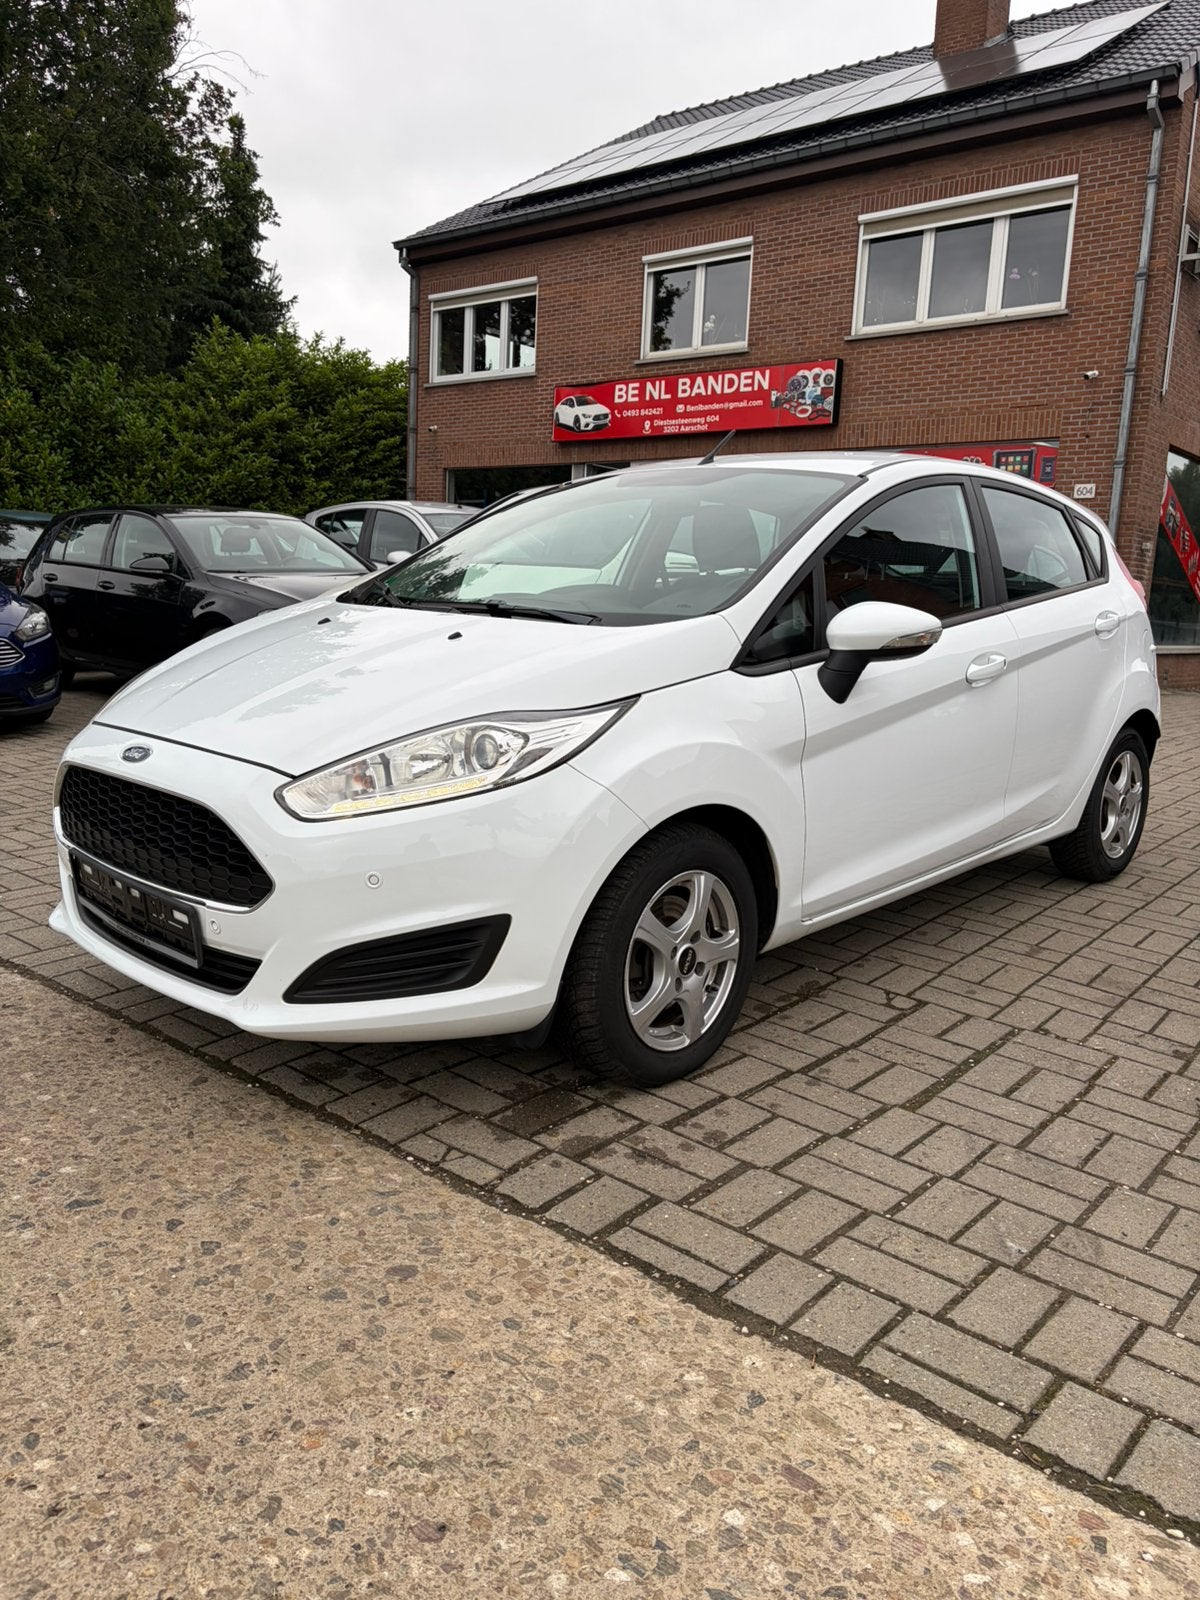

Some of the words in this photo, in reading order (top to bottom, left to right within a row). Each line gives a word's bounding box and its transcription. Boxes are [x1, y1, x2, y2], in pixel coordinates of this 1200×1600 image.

[614, 382, 640, 403] BE
[645, 380, 672, 401] NL
[677, 369, 770, 398] BANDEN
[622, 409, 639, 417] 0493
[640, 407, 663, 416] 842421
[705, 414, 720, 423] 604
[663, 425, 679, 433] 3202
[680, 423, 709, 432] Aarschot
[1076, 486, 1093, 497] 604
